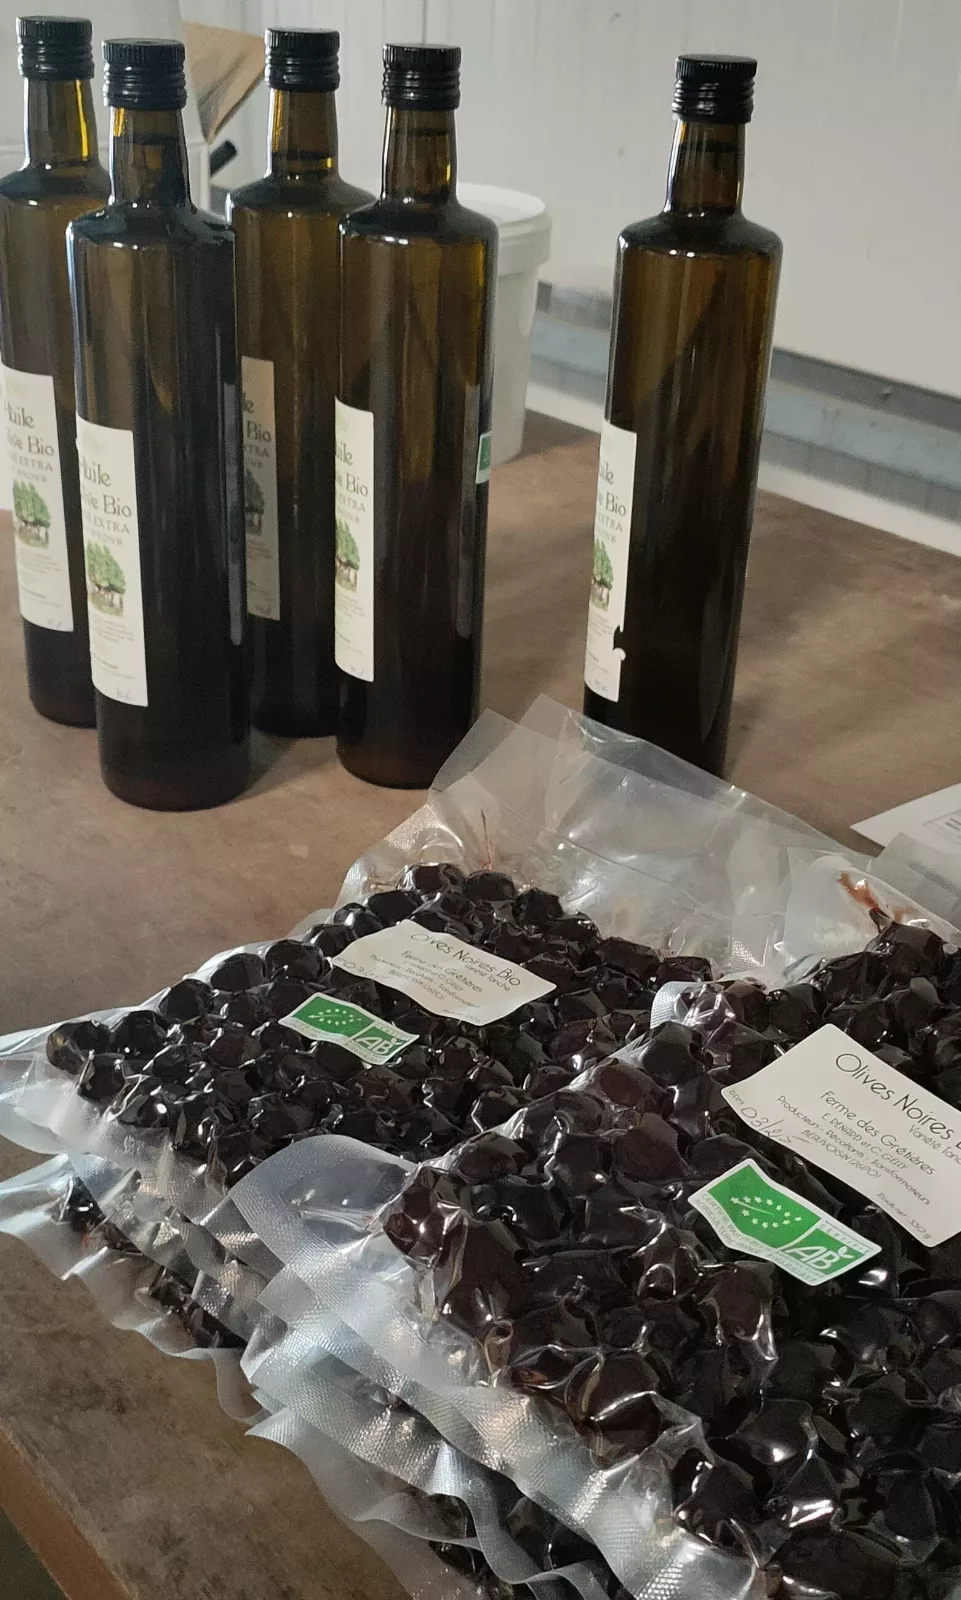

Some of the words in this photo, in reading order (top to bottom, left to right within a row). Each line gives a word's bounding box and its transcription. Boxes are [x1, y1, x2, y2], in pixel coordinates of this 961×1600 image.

[247, 420, 272, 442] Bio
[27, 435, 54, 456] Bio
[346, 472, 368, 497] Bio
[103, 494, 132, 517] Bio
[606, 491, 626, 516] Bio
[93, 515, 130, 534] EXTRA
[497, 967, 520, 986] Bio
[355, 1036, 394, 1055] AB
[836, 1053, 895, 1100] Olives
[893, 1094, 955, 1140] Noires
[820, 1090, 857, 1120] Ferme
[856, 1120, 880, 1137] des
[783, 1246, 839, 1270] AB
